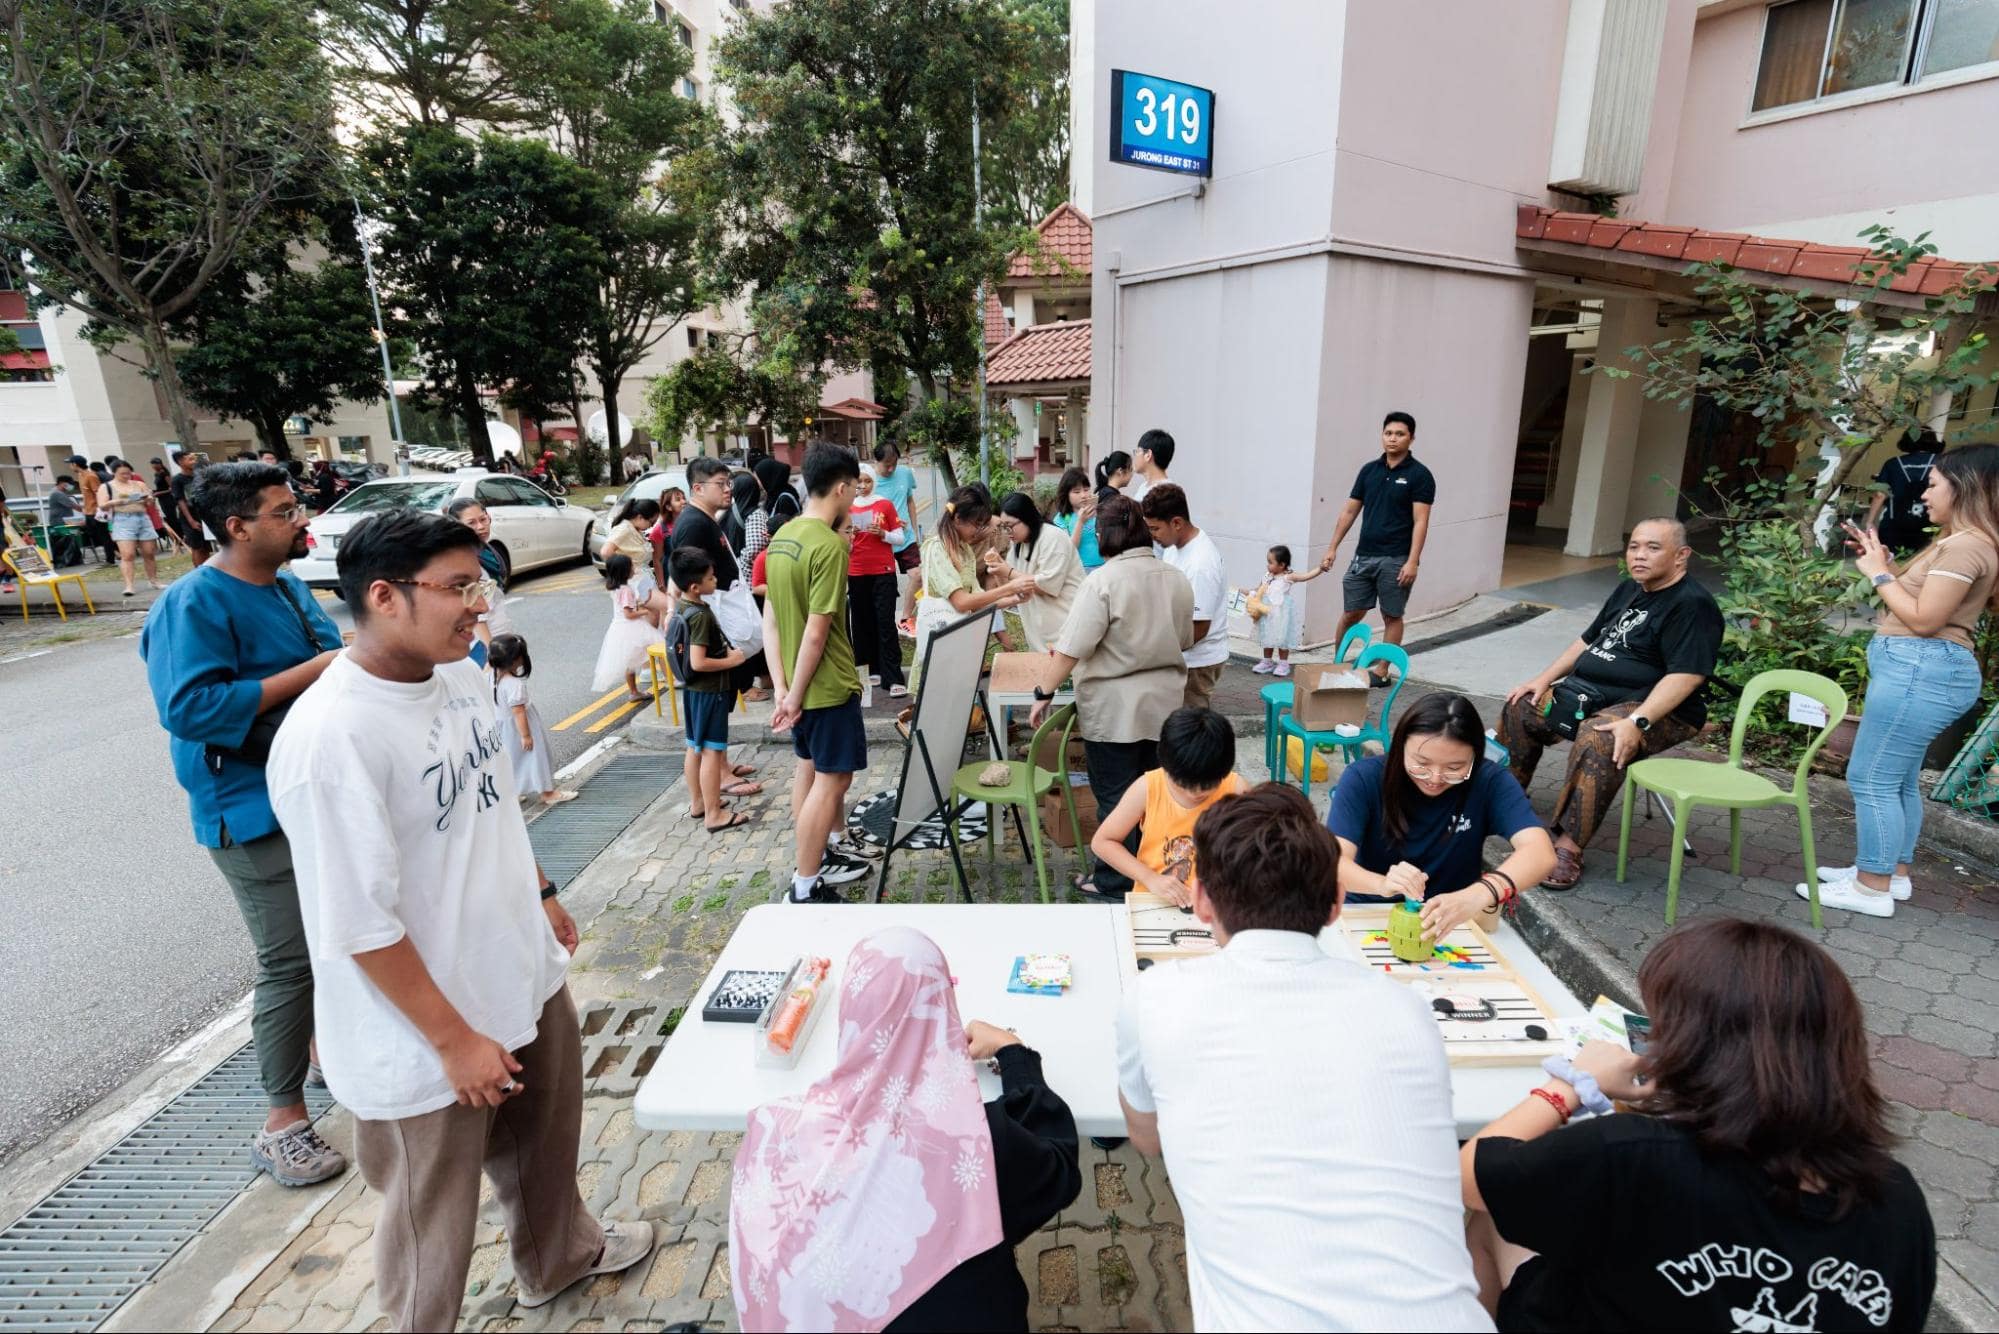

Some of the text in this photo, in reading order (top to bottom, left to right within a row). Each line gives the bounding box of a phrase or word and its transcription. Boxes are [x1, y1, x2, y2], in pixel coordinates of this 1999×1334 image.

[1135, 87, 1200, 144] 319
[1131, 150, 1163, 163] JURONG
[1164, 154, 1182, 167] EAST
[1183, 158, 1193, 169] ST
[1656, 1242, 1793, 1297] WHO
